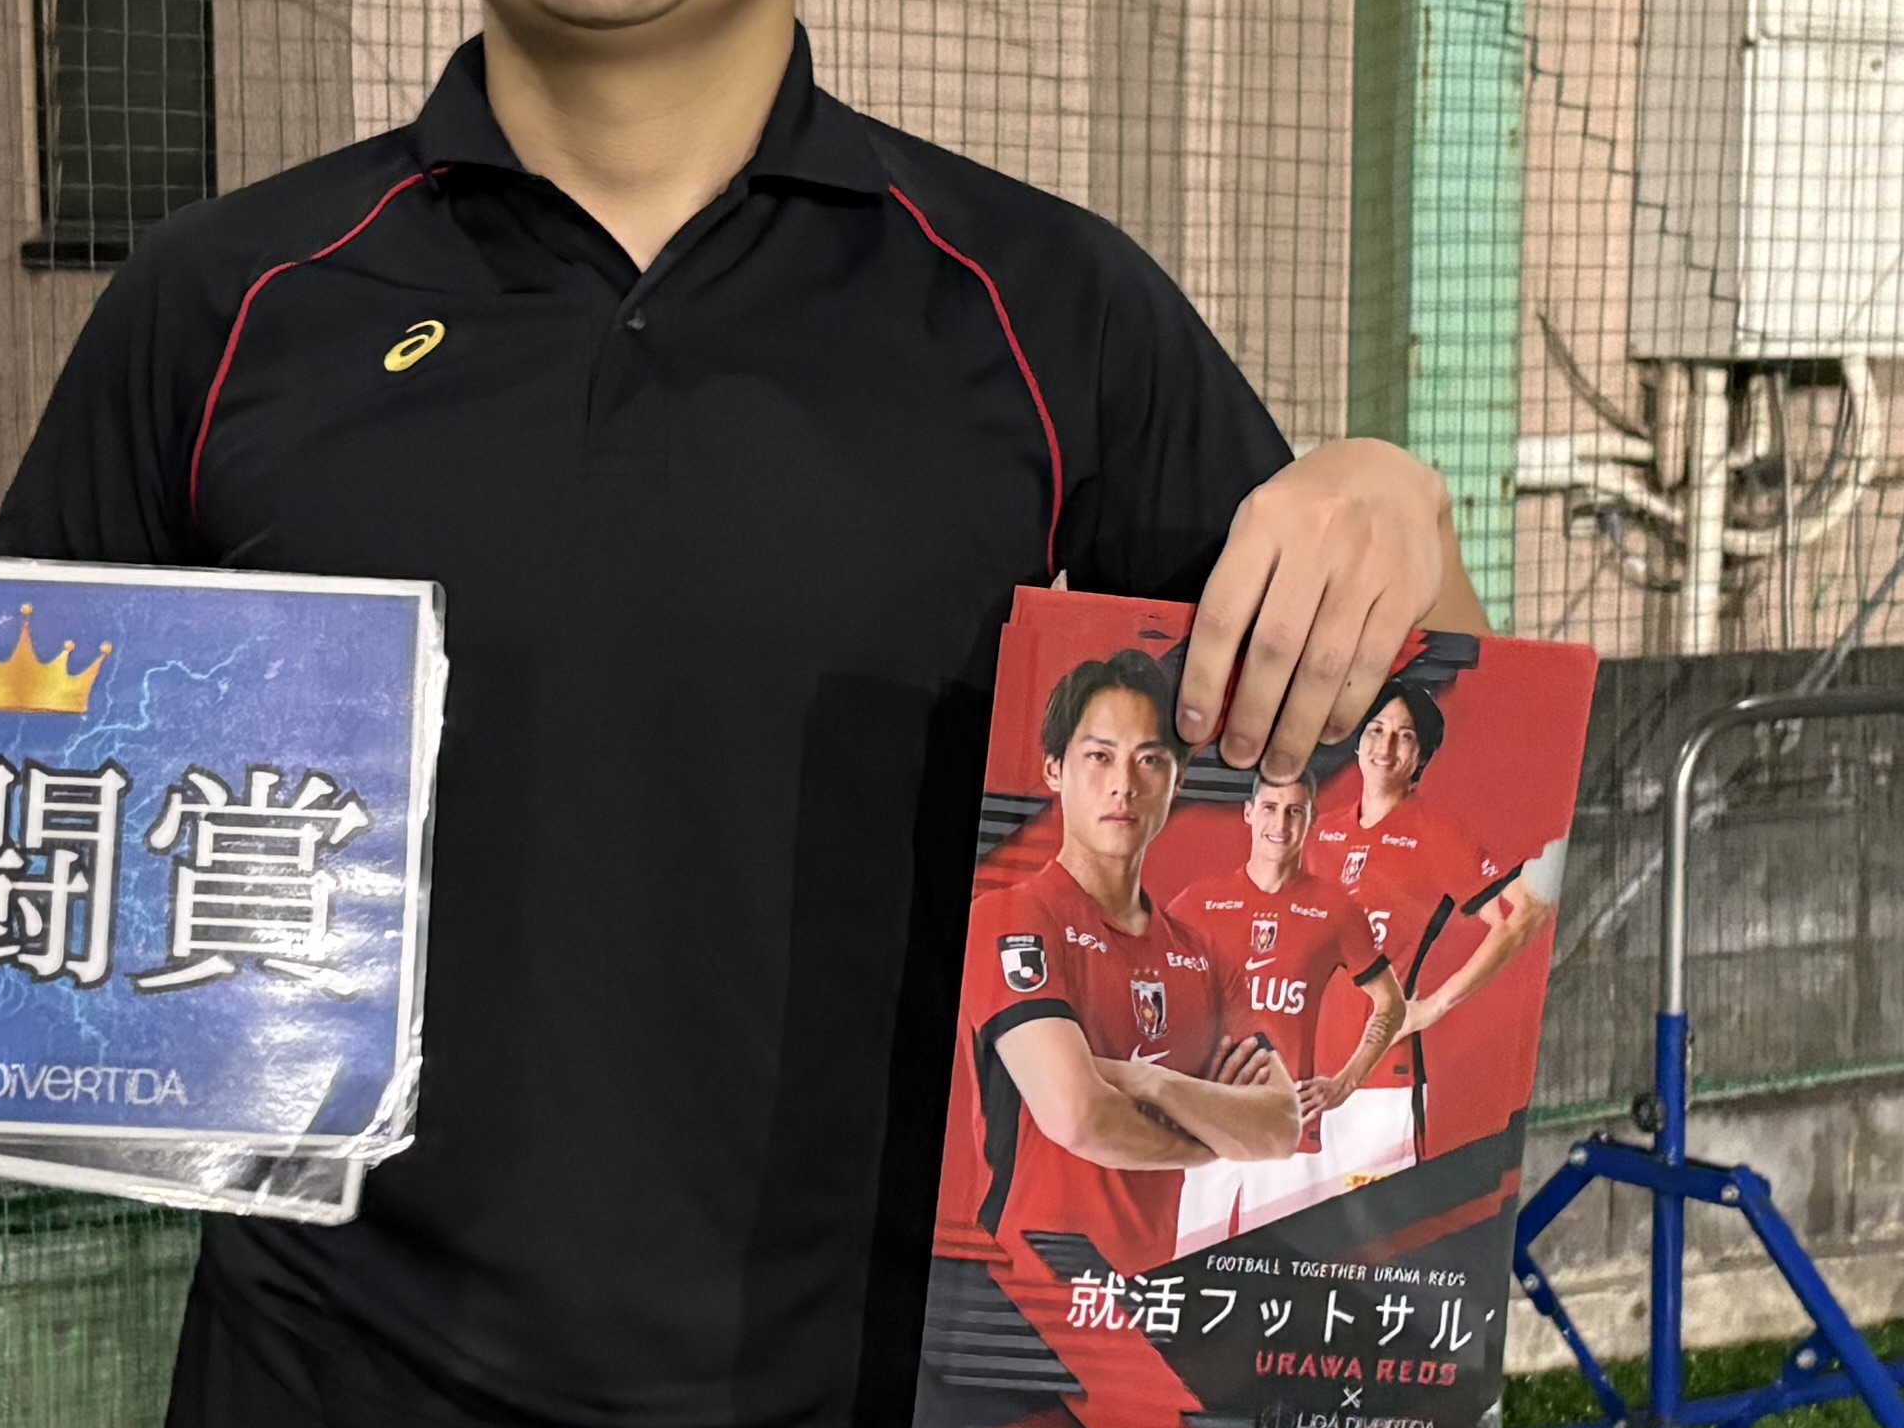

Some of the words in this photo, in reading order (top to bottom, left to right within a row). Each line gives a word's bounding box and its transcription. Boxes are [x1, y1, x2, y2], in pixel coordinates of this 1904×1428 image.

[1246, 976, 1308, 1014] LUS
[1206, 1254, 1280, 1276] FOOTBALL
[1291, 1260, 1367, 1282] TOGETHER
[1374, 1266, 1420, 1285] URAWA
[1066, 1272, 1472, 1352] 就活フットサル
[1255, 1350, 1364, 1380] URAWA
[1376, 1357, 1458, 1386] REDS
